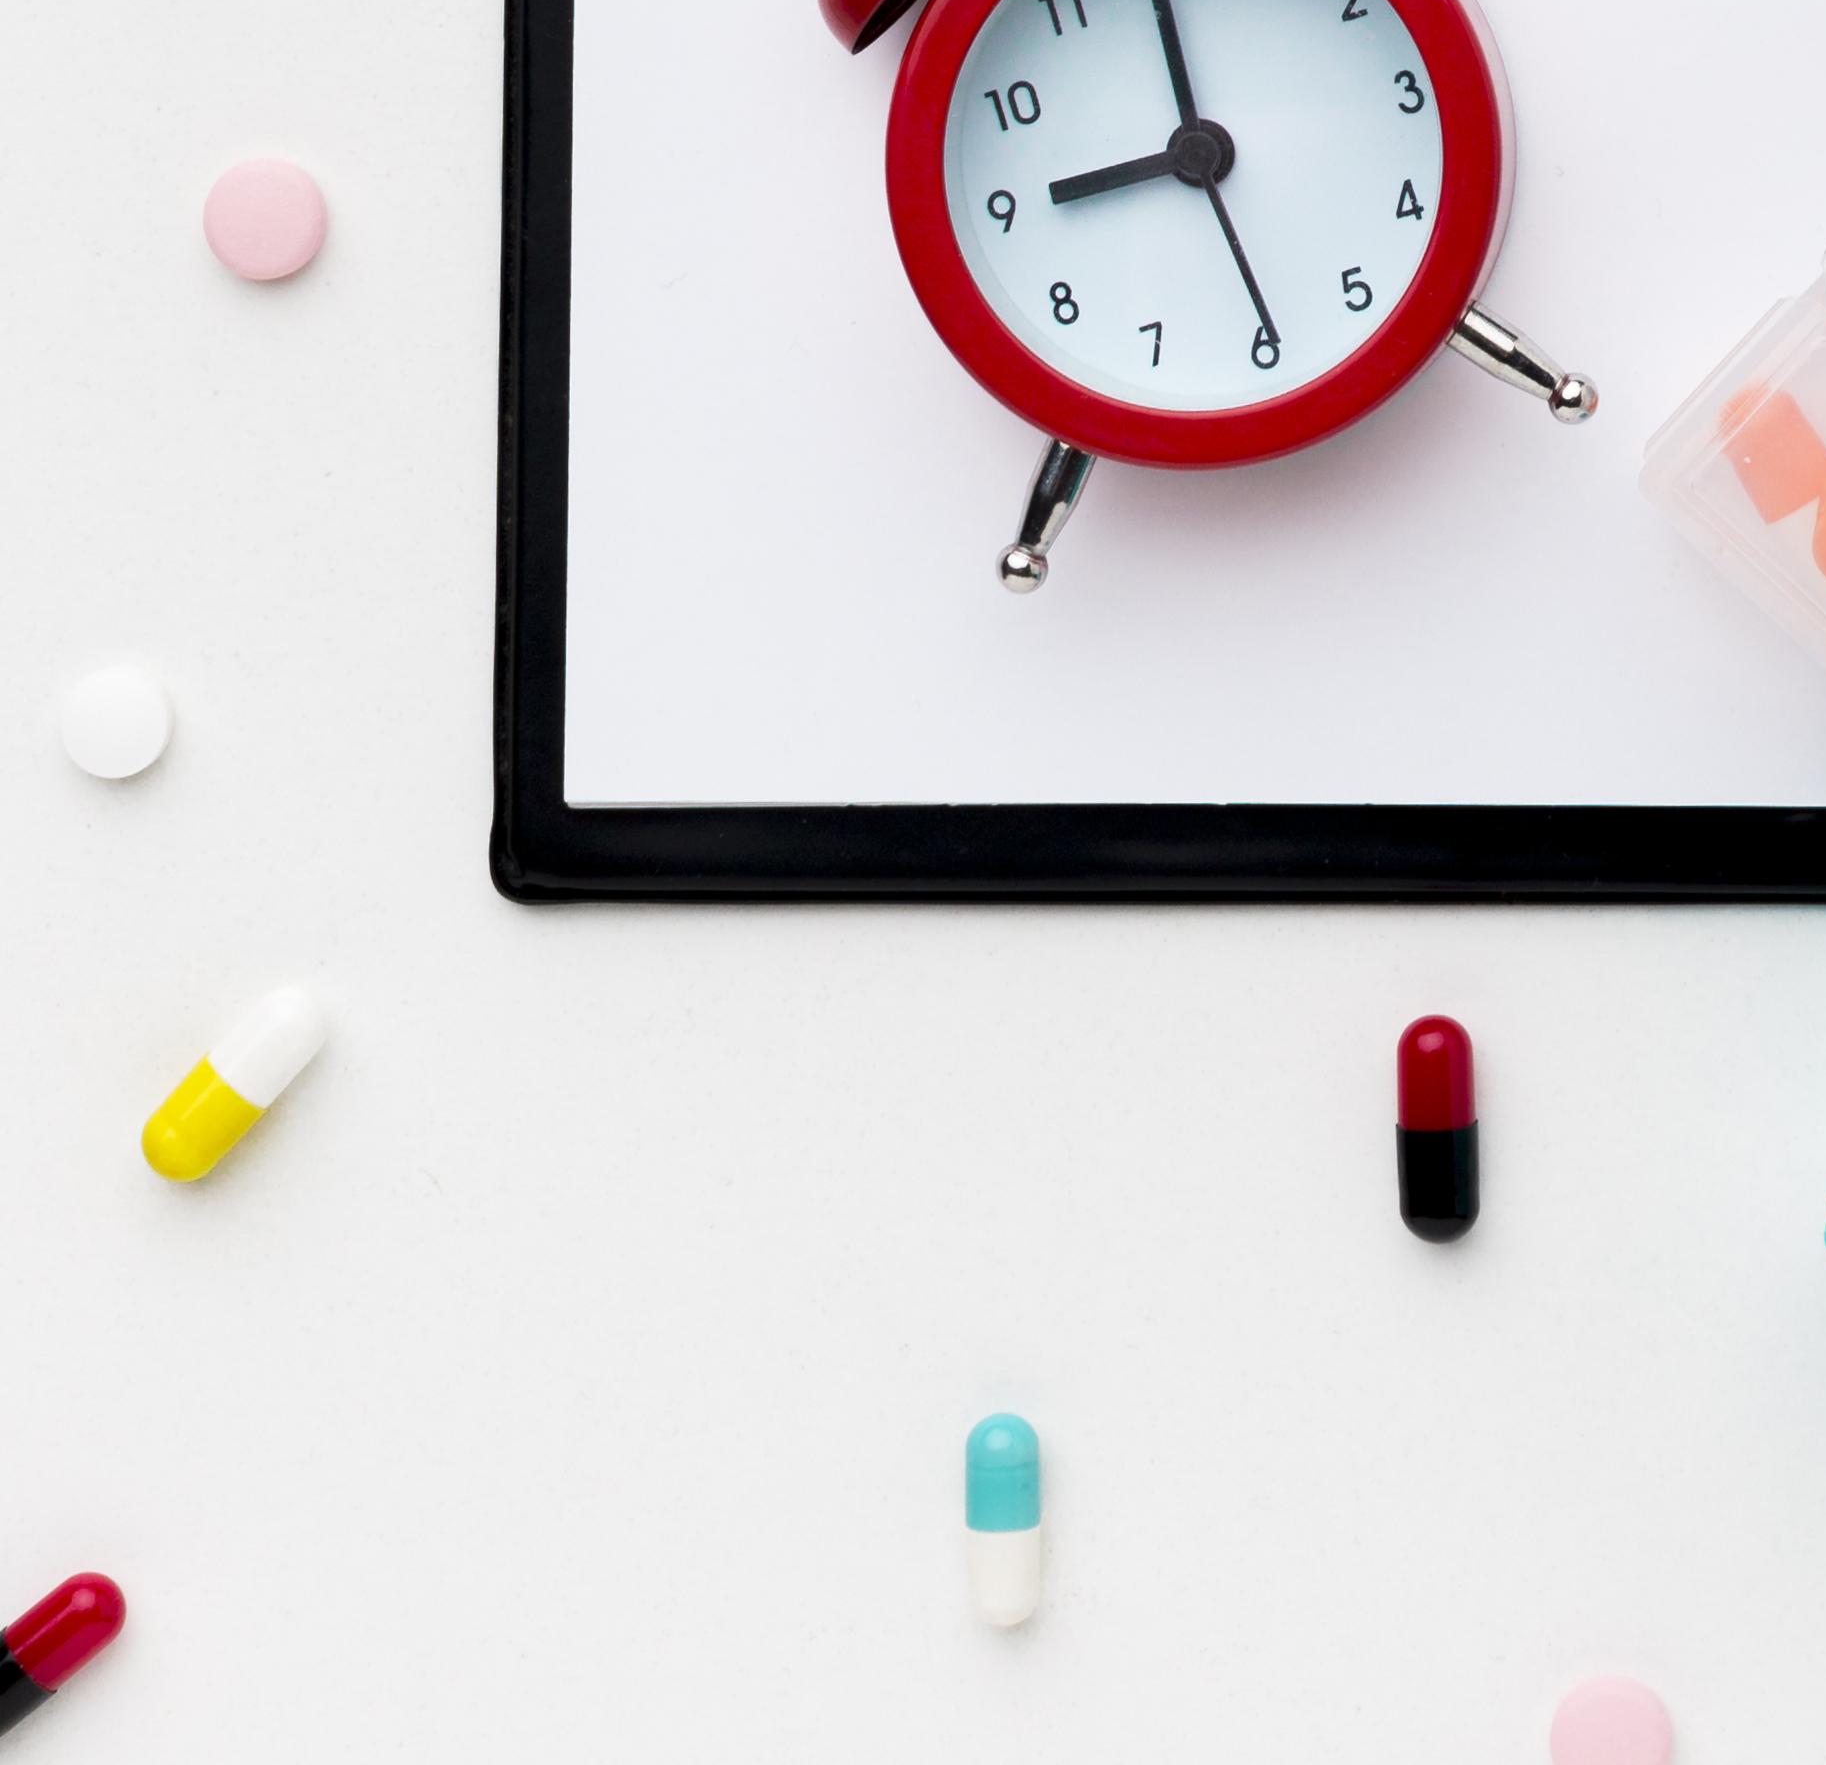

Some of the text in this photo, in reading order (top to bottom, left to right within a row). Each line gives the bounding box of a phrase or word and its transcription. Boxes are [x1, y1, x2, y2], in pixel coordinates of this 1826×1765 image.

[984, 80, 1041, 131] 10
[1394, 69, 1425, 114] 3
[987, 189, 1016, 233] 9
[1396, 179, 1424, 220] 4
[1049, 281, 1079, 325] 8
[1341, 267, 1373, 312] 5
[1139, 321, 1162, 367] 7
[1251, 324, 1281, 369] 6
